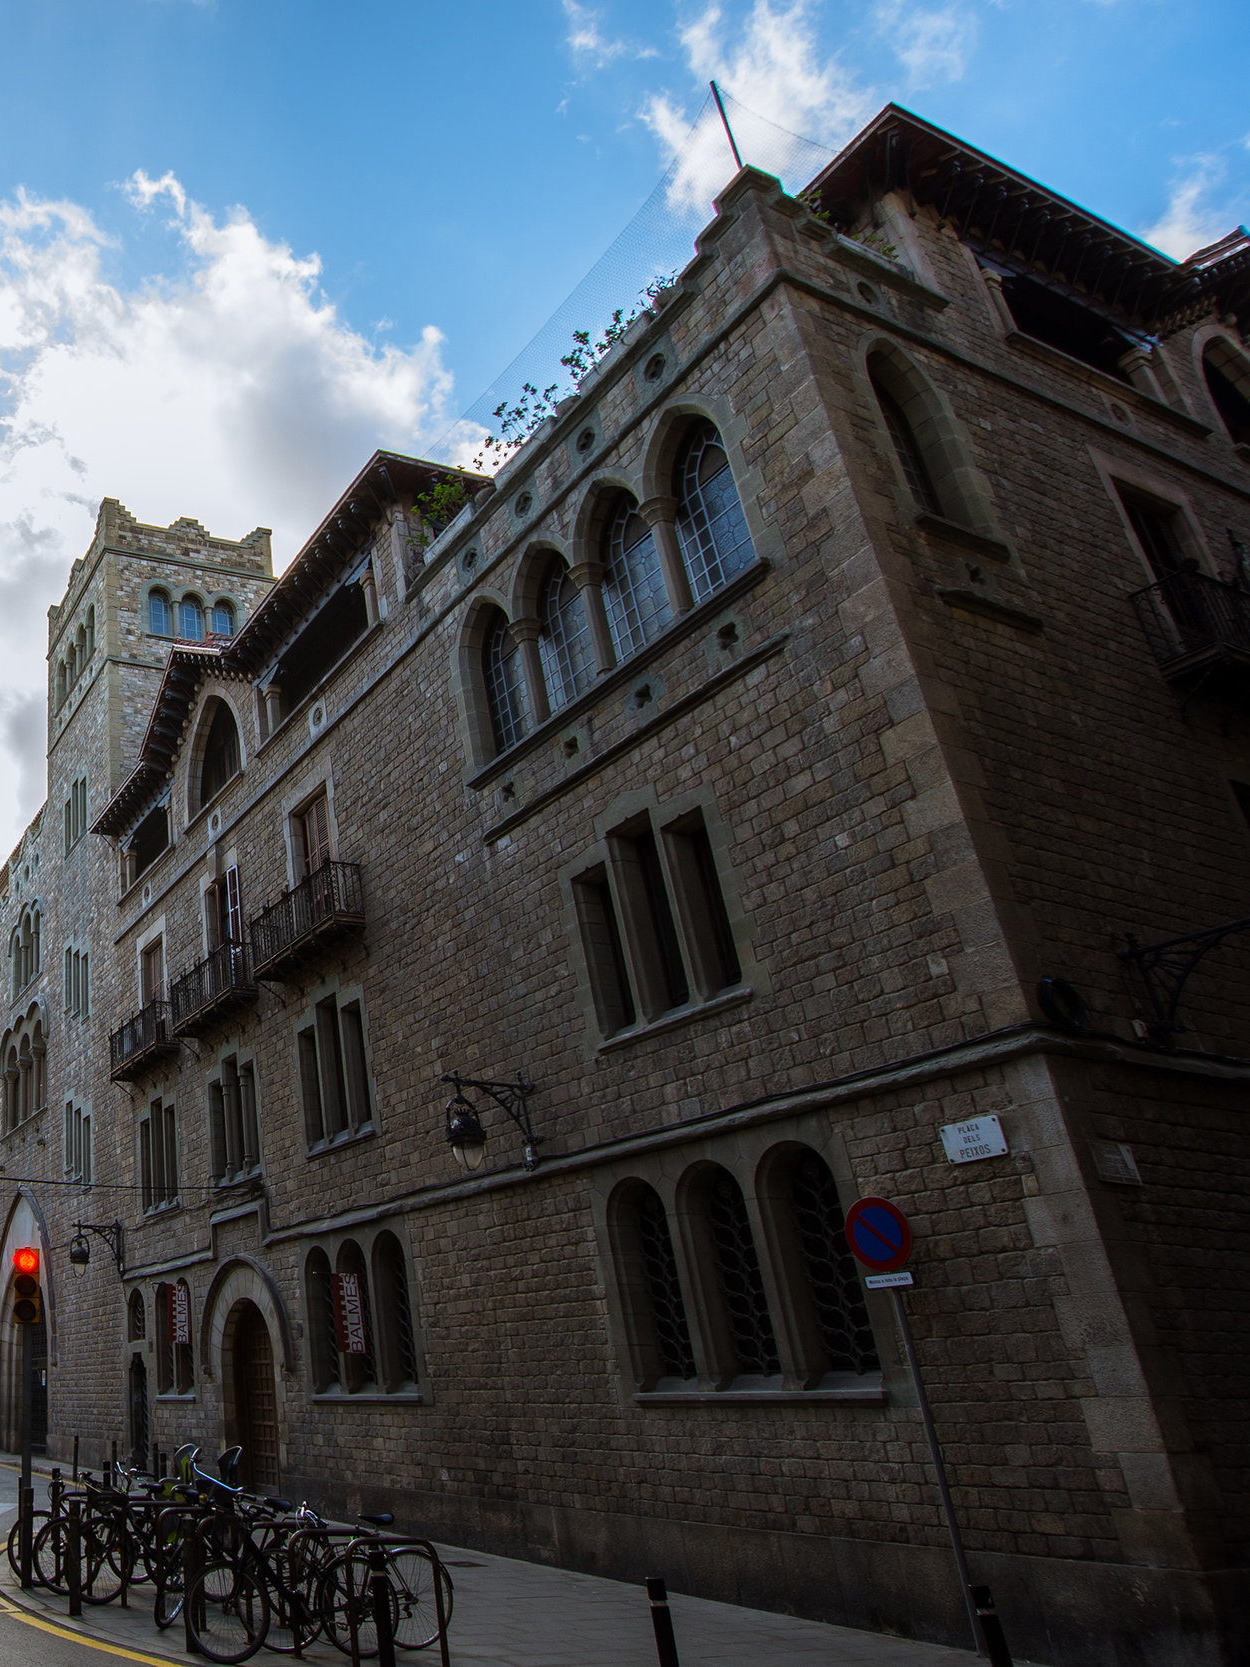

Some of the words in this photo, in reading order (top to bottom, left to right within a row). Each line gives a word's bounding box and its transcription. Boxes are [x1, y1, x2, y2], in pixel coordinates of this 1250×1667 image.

[959, 1143, 991, 1159] PEIXOS
[962, 1133, 981, 1144] DELS
[177, 1283, 188, 1344] BALMES
[345, 1272, 364, 1353] BALMES
